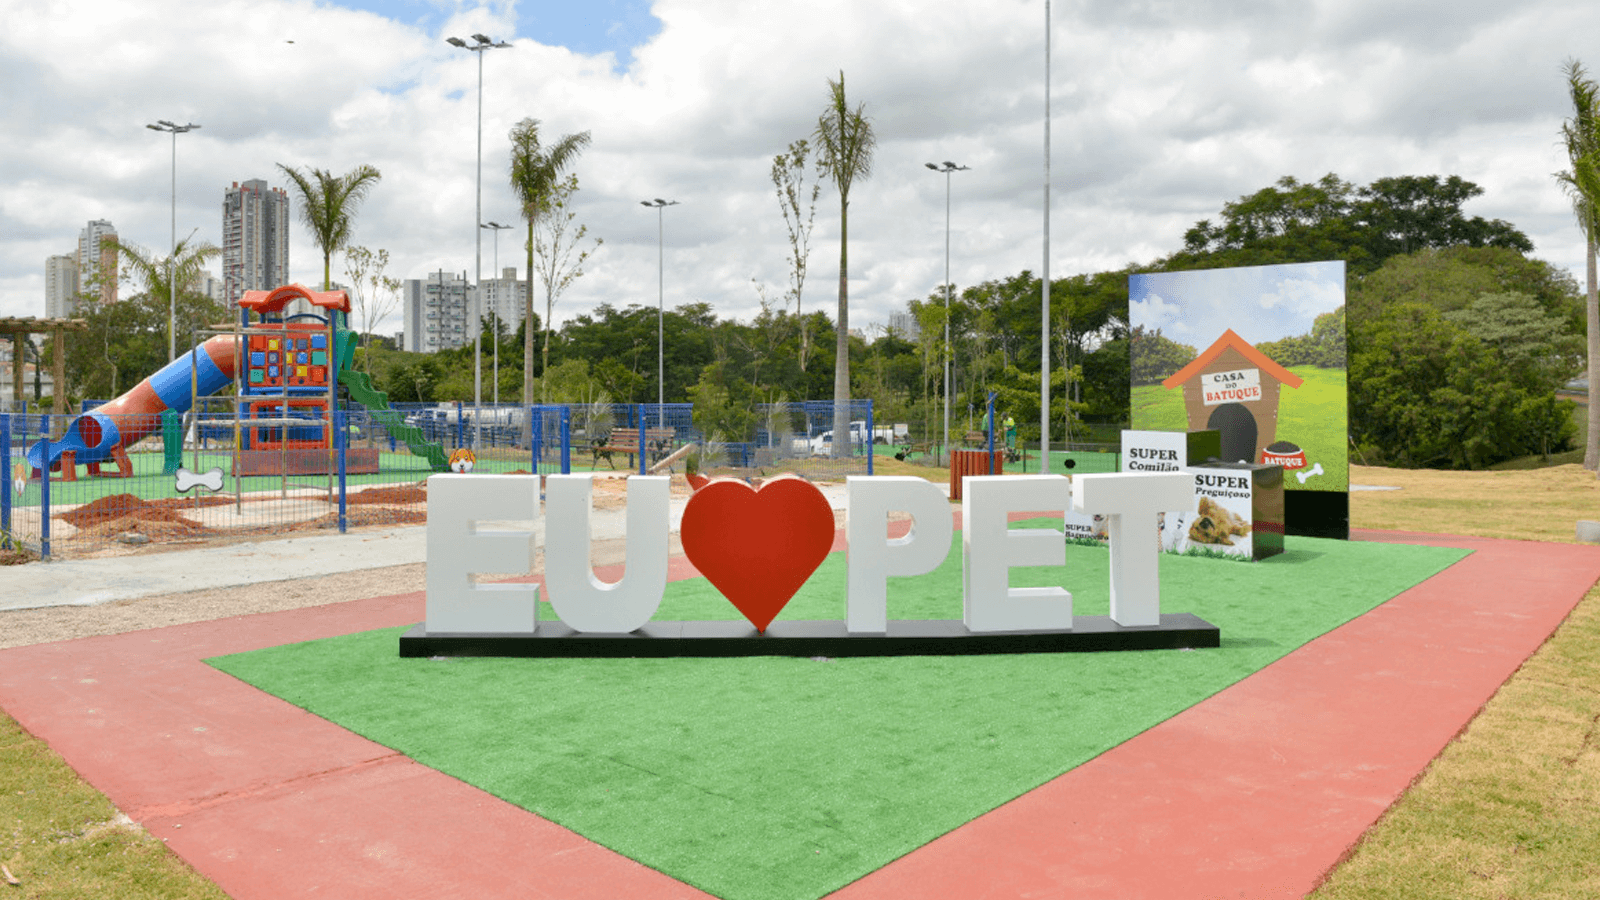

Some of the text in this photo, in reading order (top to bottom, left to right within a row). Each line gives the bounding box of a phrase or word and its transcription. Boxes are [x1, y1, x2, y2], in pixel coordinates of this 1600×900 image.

[1214, 372, 1245, 383] CASA
[1206, 387, 1260, 401] BATUQUE
[1130, 448, 1178, 460] SUPER
[1129, 461, 1180, 472] Comilão
[1264, 456, 1303, 467] BATUQUE
[1195, 475, 1249, 489] SUPER
[1195, 487, 1251, 499] Preguiçoso
[1065, 524, 1092, 532] SUPER
[425, 472, 1195, 634] EU PET
